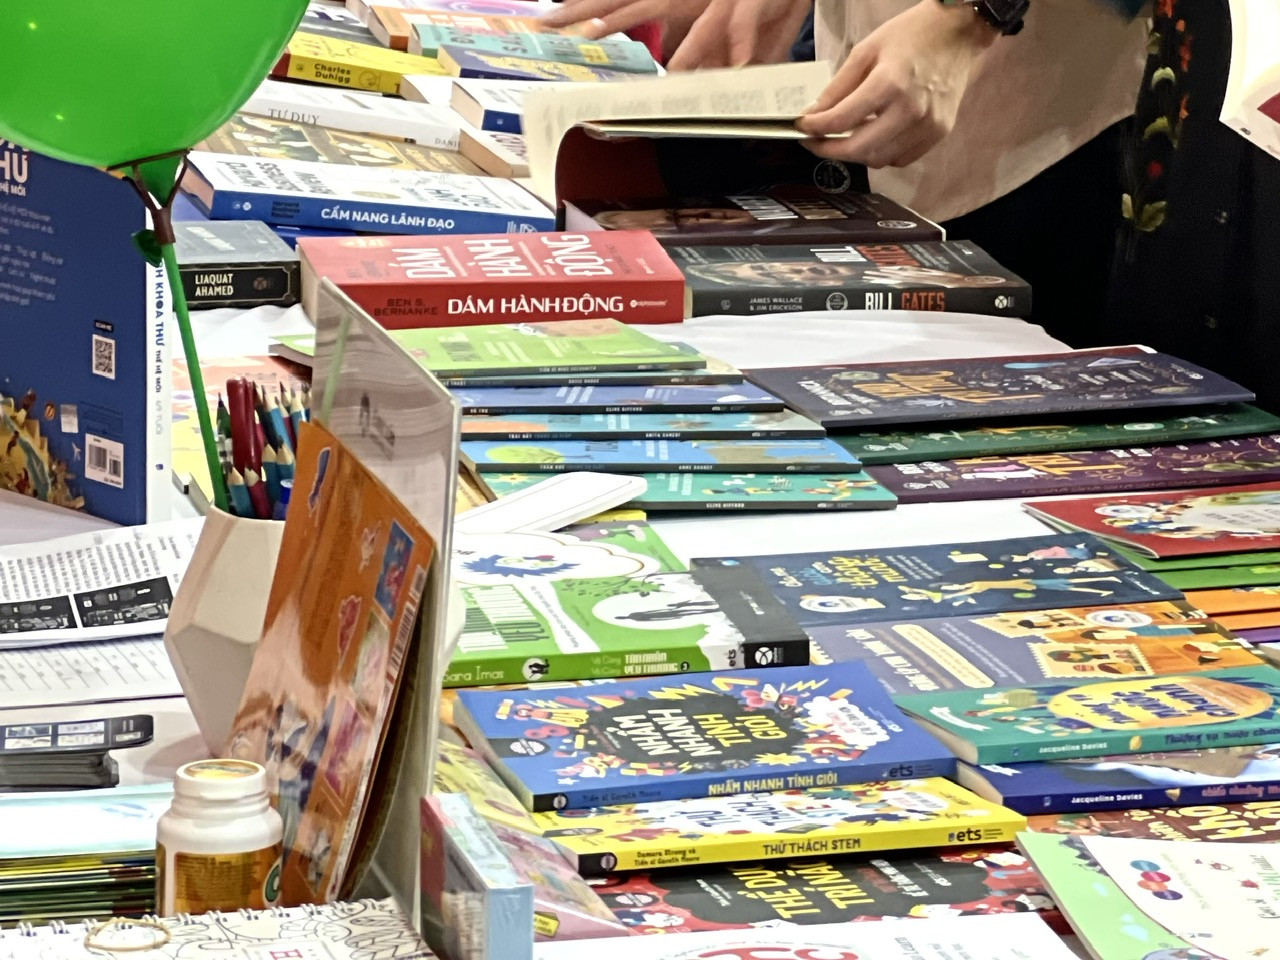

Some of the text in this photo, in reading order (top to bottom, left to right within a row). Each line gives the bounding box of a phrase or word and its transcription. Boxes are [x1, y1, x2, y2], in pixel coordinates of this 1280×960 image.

[314, 63, 351, 76] Charles
[315, 71, 350, 84] Duhigg
[290, 111, 320, 125] DUY
[352, 210, 389, 224] NANG
[391, 211, 426, 227] LÃNH
[427, 218, 455, 231] ĐẠO
[388, 248, 457, 279] DÁM
[463, 239, 533, 279] HÀNH
[540, 234, 614, 278] ĐỘNG
[195, 273, 233, 285] LIAQUAT
[155, 281, 164, 319] KHOA
[195, 285, 234, 297] AHAMED
[772, 296, 803, 304] WALLACE
[387, 298, 413, 308] BEN
[447, 293, 624, 316] DÁM HÀNH ĐỘNG
[901, 292, 945, 312] GATES
[374, 306, 439, 317] BERNANKE
[155, 321, 165, 347] THƯ
[476, 665, 505, 681] Imas
[1143, 683, 1240, 717] chanh
[606, 714, 680, 756] NHẨM
[648, 708, 723, 757] NHANH
[692, 713, 752, 747] TÍNH
[1039, 744, 1080, 755] Jacqueline
[1081, 742, 1108, 751] Davies
[888, 763, 914, 778] ets
[743, 777, 784, 792] NHANH
[787, 773, 814, 789] TÍNH
[1071, 795, 1114, 805] Jacqueline
[1116, 792, 1144, 802] Davies
[957, 828, 982, 842] ets
[763, 838, 861, 856] THỬ THÁCH STEM
[657, 856, 679, 865] Gareth
[803, 884, 876, 910] TRÍ
